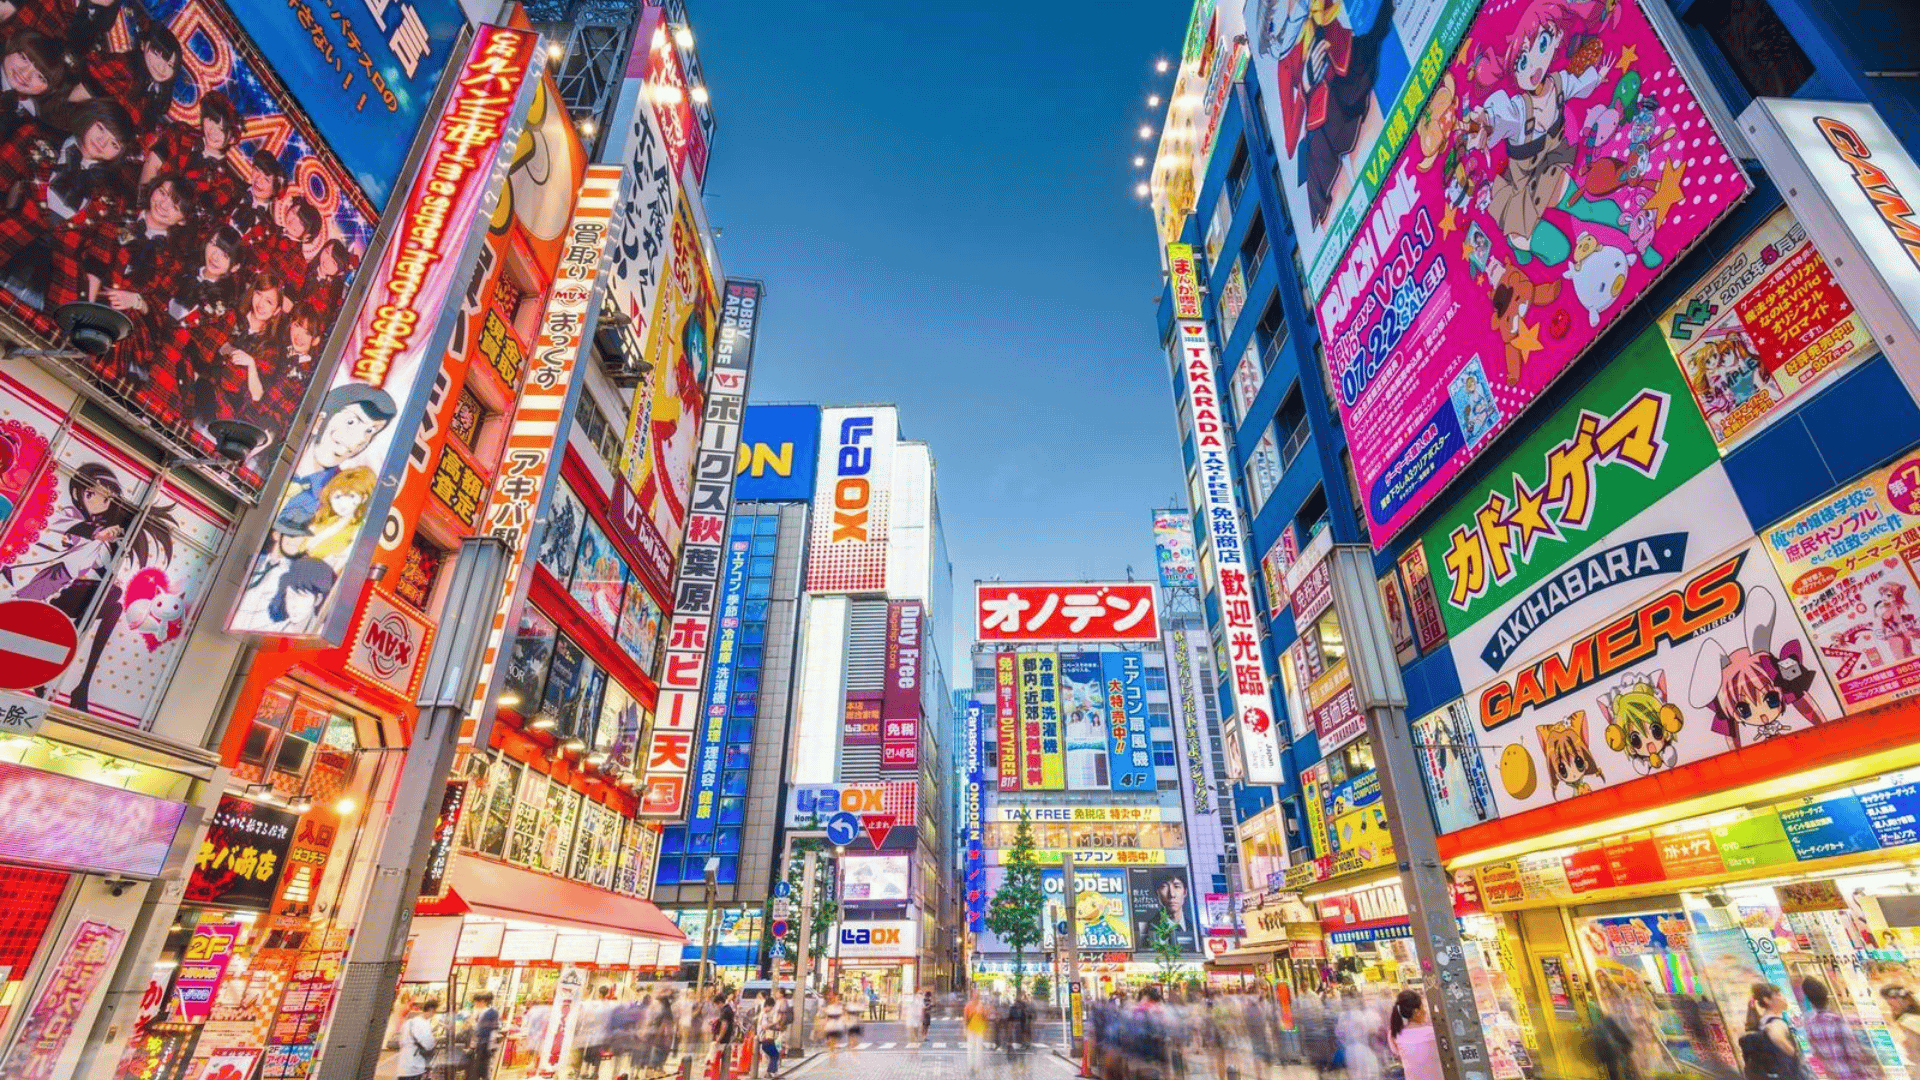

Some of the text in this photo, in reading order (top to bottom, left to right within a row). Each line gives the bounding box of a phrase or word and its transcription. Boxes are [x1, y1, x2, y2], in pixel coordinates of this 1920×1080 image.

[566, 221, 604, 281] 買取り
[1320, 226, 1380, 343] PUNCH
[1372, 157, 1421, 258] LINE
[717, 284, 742, 365] PARADISE
[737, 285, 757, 340] HOBBY
[1343, 306, 1402, 406] 07.22
[1395, 276, 1416, 310] ON
[1771, 290, 1824, 335] オリジナル
[533, 312, 578, 390] まっくす
[1186, 347, 1221, 447] TAKARADA
[1210, 506, 1242, 565] 免税商店
[648, 396, 741, 809] ボークス秋葉原ホビー天国
[981, 586, 1151, 633] オノデン
[1496, 540, 1660, 658] AKIHABARA
[1219, 567, 1265, 697] 歓迎光臨
[1479, 547, 1751, 732] GAMERS
[898, 648, 919, 689] Free
[967, 707, 980, 774] Panasonic
[1121, 773, 1147, 786] 4F
[298, 820, 335, 847] 入口
[868, 820, 890, 830] 止まれ
[970, 782, 981, 841] ONODEN
[1004, 808, 1032, 820] TAX
[1035, 808, 1072, 820] FREE
[1073, 850, 1114, 863] エアコン
[184, 934, 231, 961] 2F
